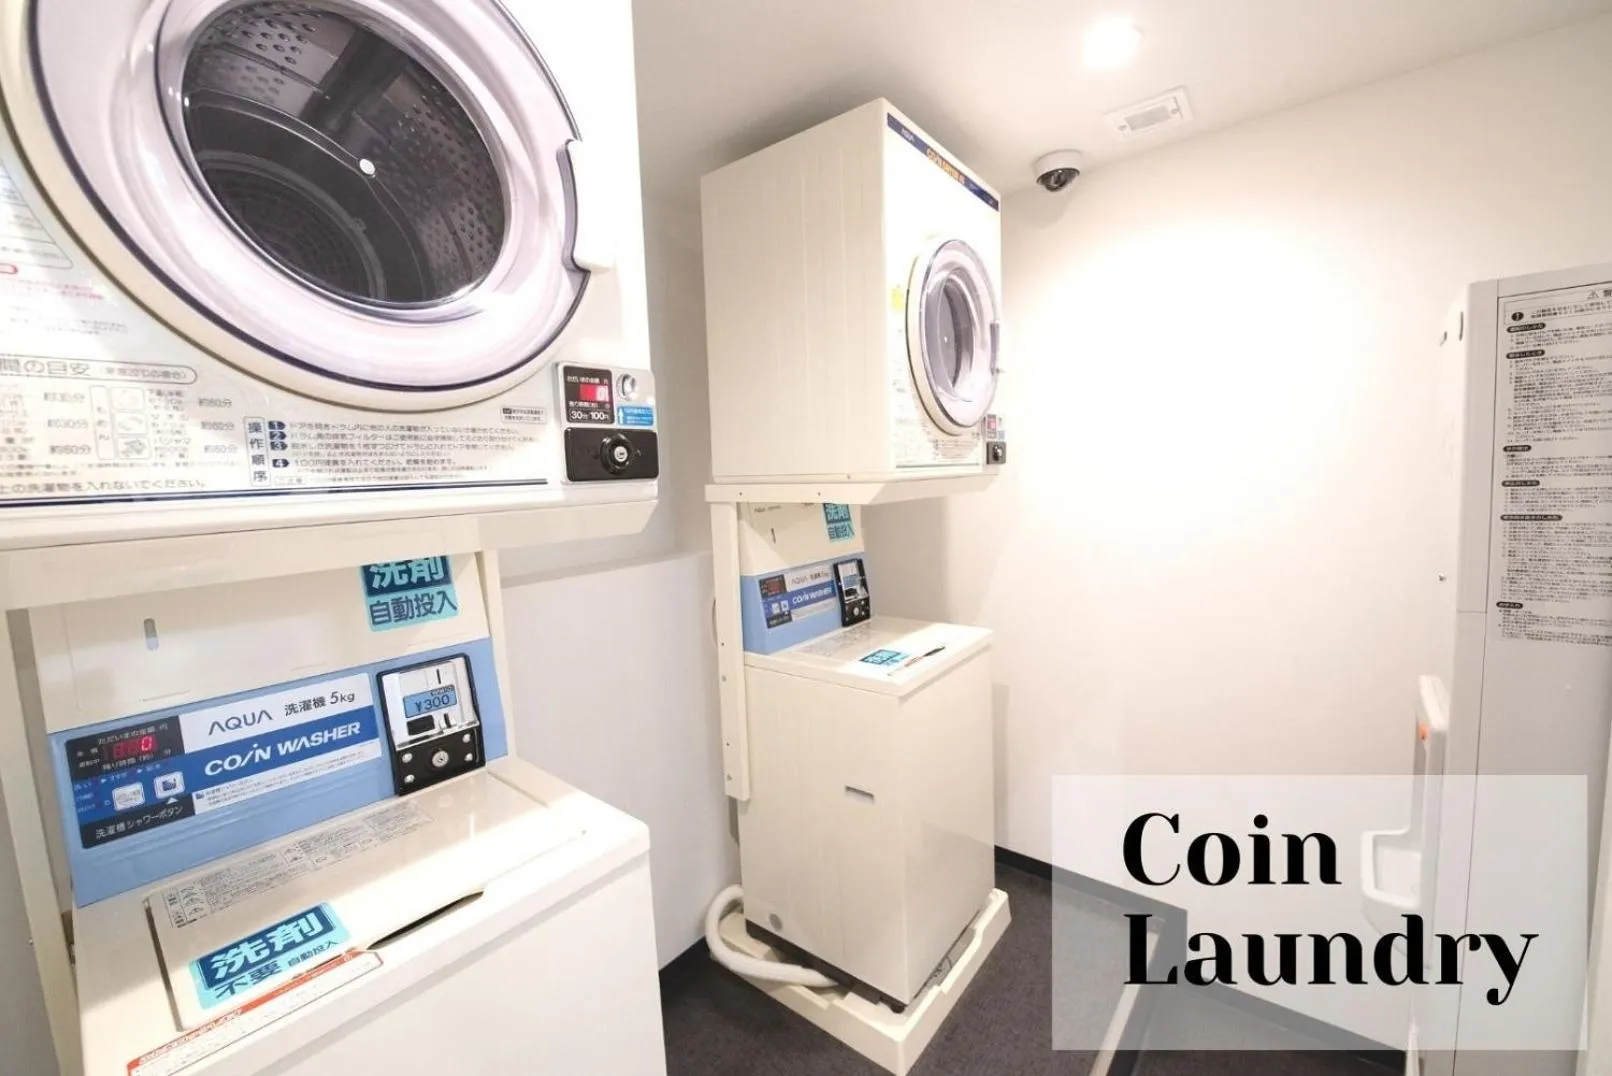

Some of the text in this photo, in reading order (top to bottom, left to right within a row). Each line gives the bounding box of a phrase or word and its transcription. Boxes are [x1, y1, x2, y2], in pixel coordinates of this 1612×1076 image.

[247, 420, 268, 483] 操作順序
[369, 590, 458, 626] 自動投入
[208, 691, 355, 736] AQUA 洗濯機 5kg
[415, 694, 450, 712] ¥300
[204, 743, 271, 776] COIN
[276, 721, 361, 757] WASHER
[210, 911, 325, 979] 洗剤
[215, 940, 339, 999] 不要 自動投入
